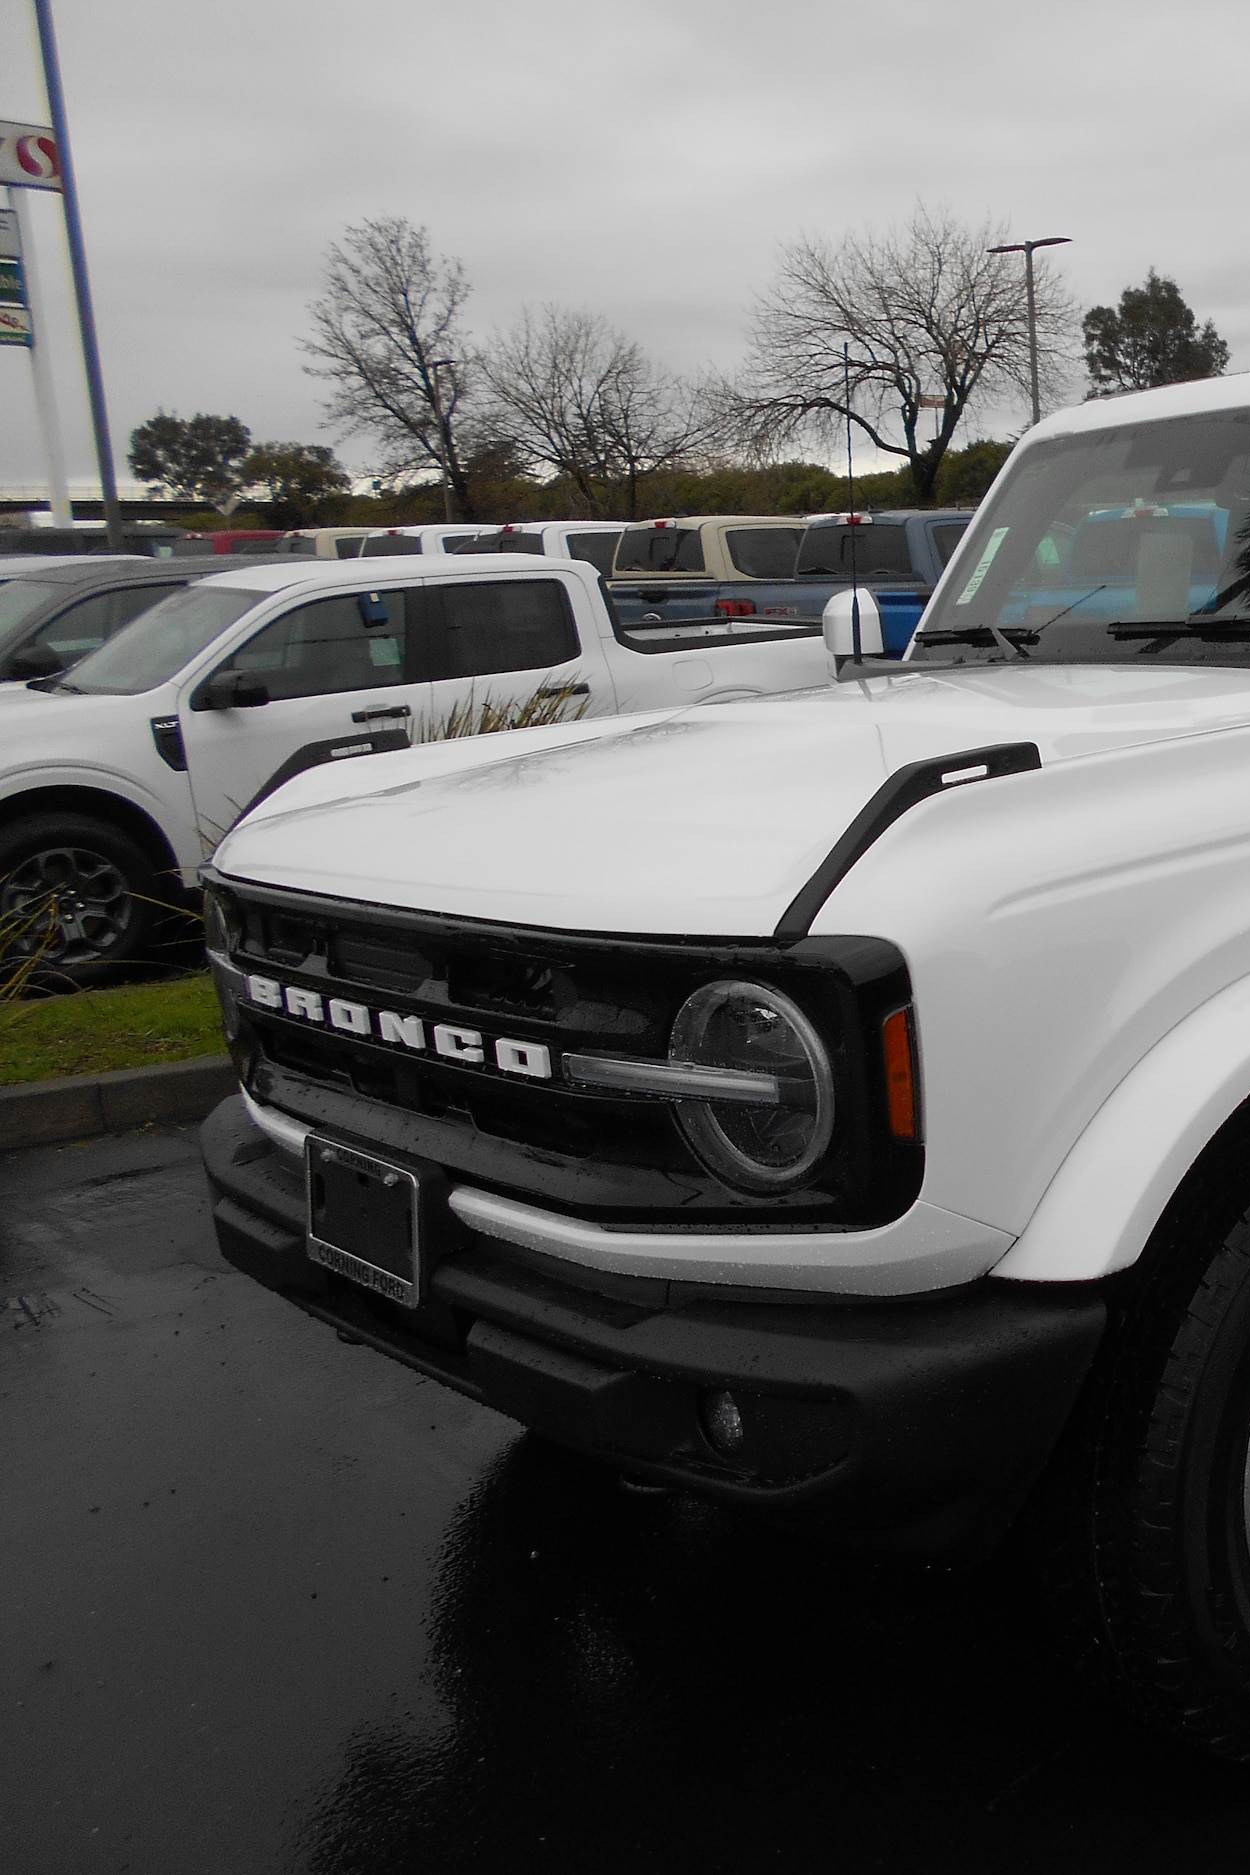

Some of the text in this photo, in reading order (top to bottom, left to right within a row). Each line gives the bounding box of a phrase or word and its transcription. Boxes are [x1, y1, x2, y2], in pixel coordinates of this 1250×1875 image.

[154, 721, 179, 730] XLT
[248, 974, 553, 1079] BRONCO
[336, 1148, 381, 1177] CORNING
[318, 1244, 405, 1299] CORNING FORD
